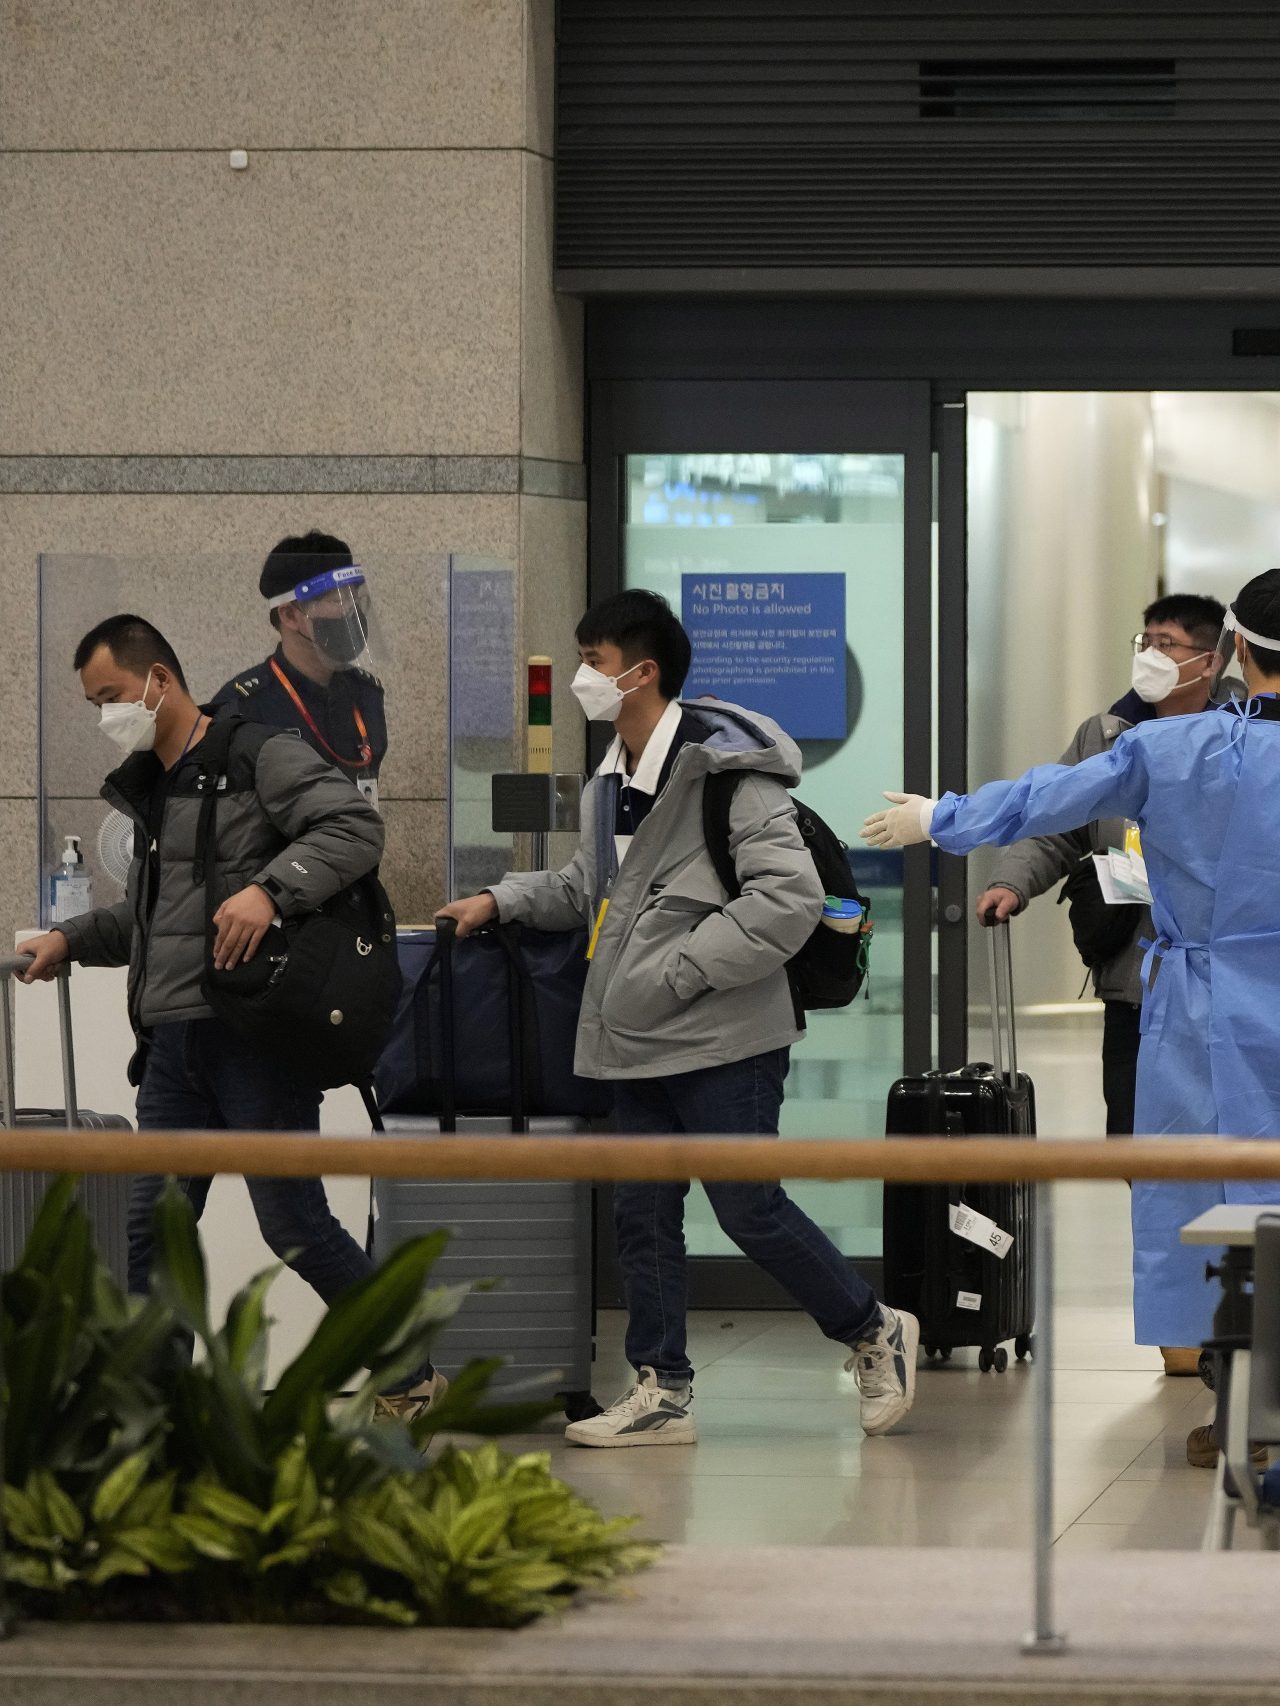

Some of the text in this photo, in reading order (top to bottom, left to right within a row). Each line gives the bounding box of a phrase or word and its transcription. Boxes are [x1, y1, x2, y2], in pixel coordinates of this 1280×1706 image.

[692, 603, 812, 615] No Photo is allowed
[746, 656, 760, 664] the
[988, 1231, 1002, 1247] 45
